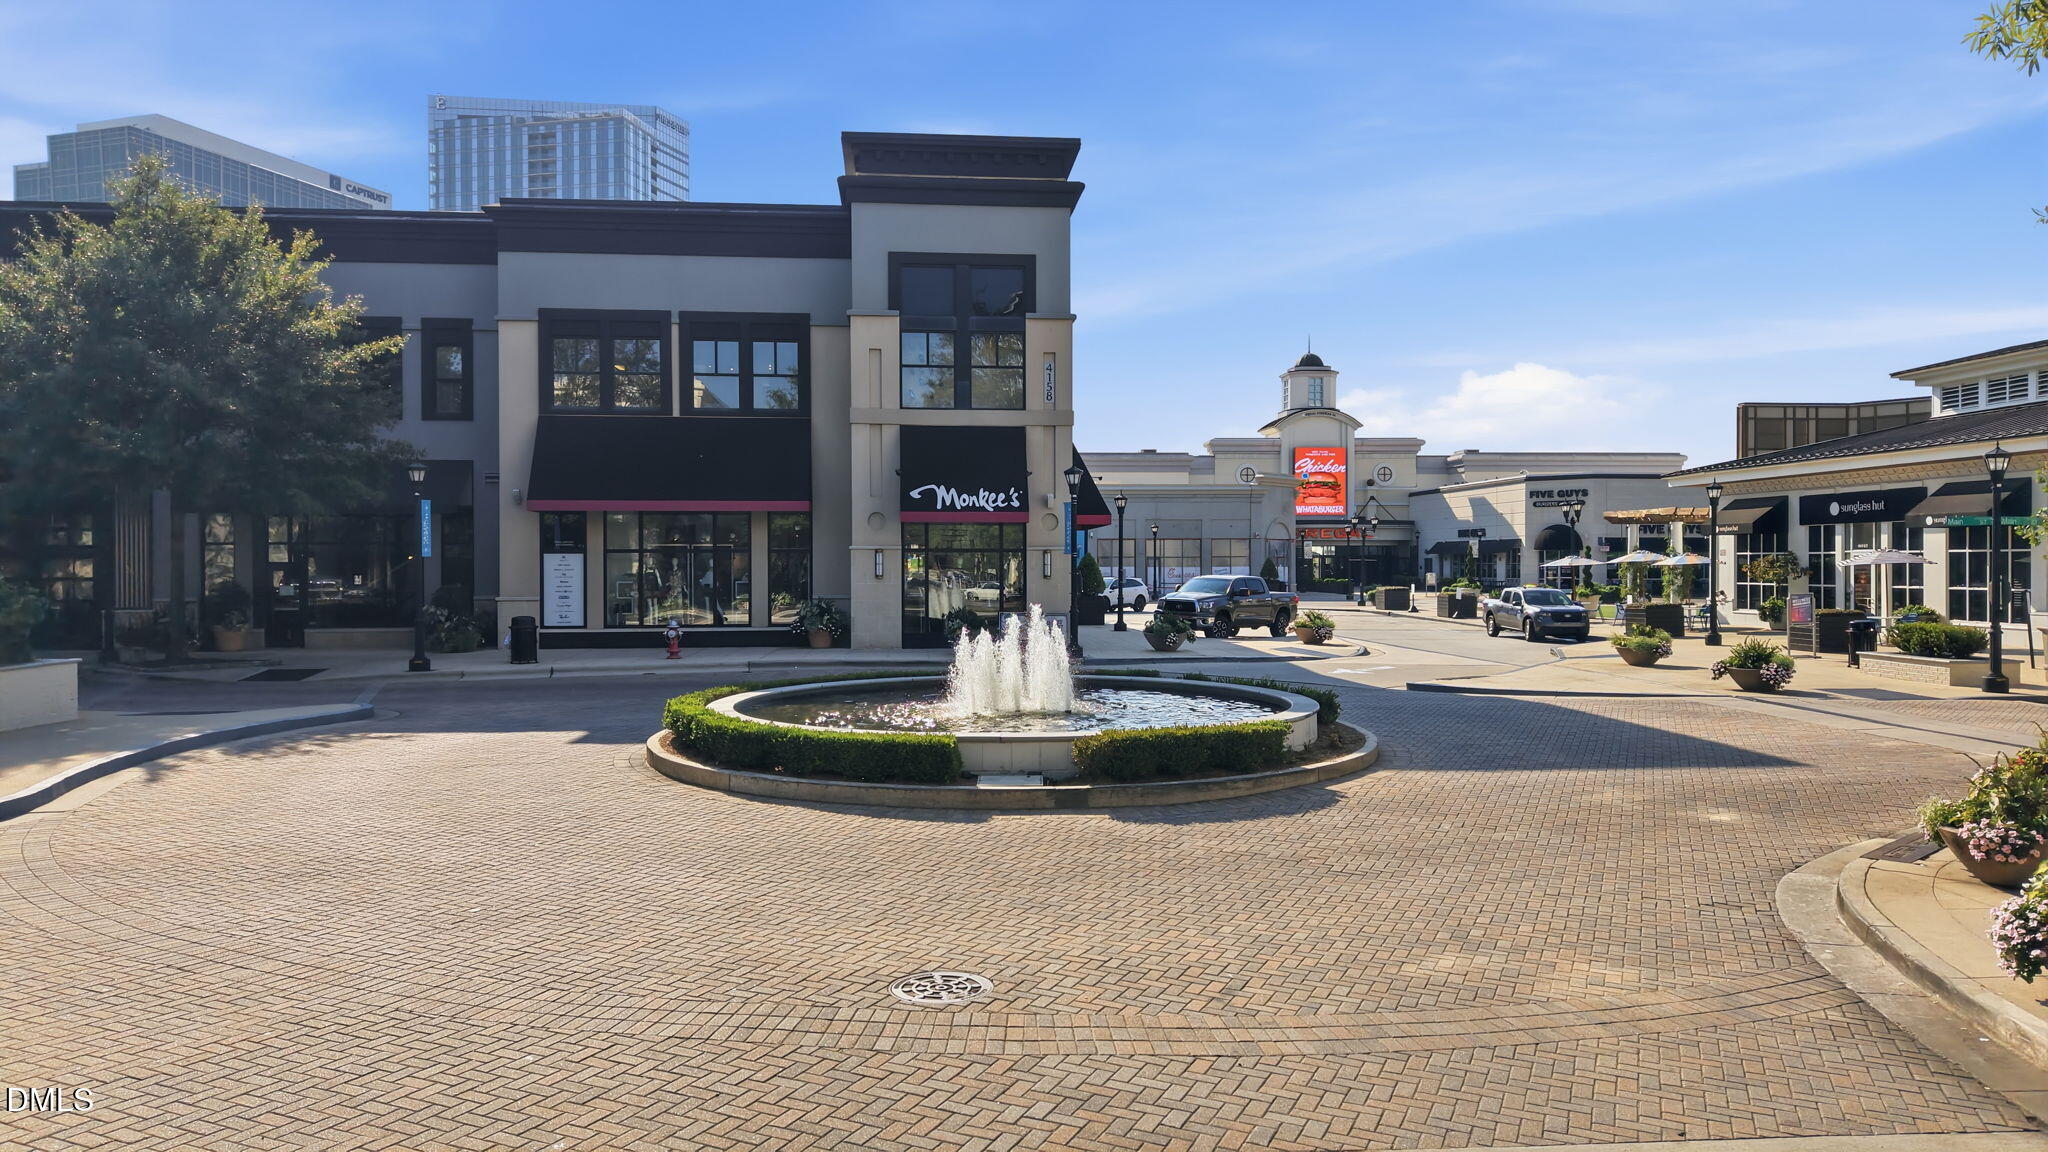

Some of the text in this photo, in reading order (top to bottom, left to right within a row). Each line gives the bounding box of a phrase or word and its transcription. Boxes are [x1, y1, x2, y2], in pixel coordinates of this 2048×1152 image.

[346, 183, 388, 204] CAPTRUST
[1294, 458, 1347, 473] Chicken
[909, 484, 1021, 512] Monkee's
[1529, 488, 1589, 499] FIVE GUYS
[1295, 505, 1345, 514] WHATABURGER
[1840, 500, 1885, 515] sunglass hut
[1947, 517, 1964, 526] Main
[1639, 524, 1665, 535] FIVE
